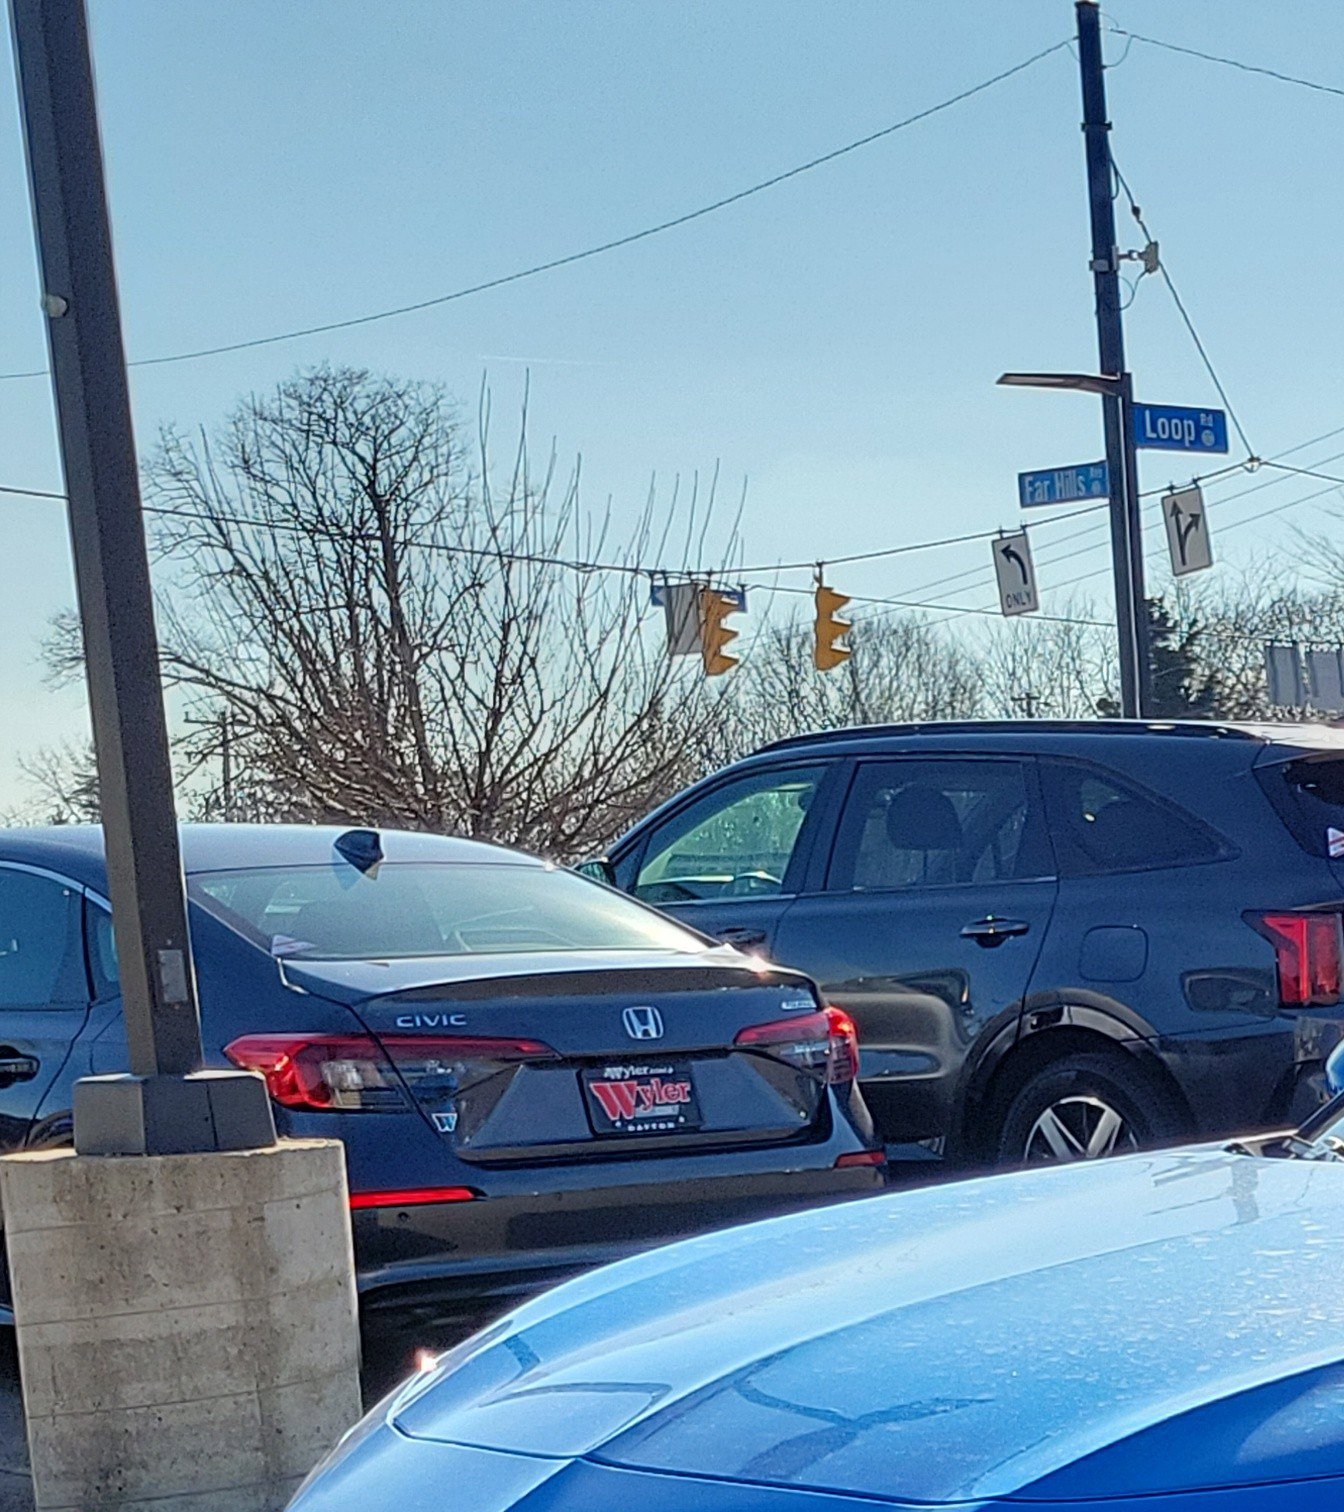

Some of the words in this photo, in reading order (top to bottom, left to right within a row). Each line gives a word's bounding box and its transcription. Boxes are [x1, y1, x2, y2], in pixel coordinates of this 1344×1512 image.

[1144, 409, 1195, 447] Loop
[1024, 476, 1050, 504] Far
[1054, 470, 1086, 499] Hills
[396, 1014, 467, 1027] CIVIC
[589, 1078, 691, 1121] Wyler
[627, 1122, 675, 1132] DAYTON
